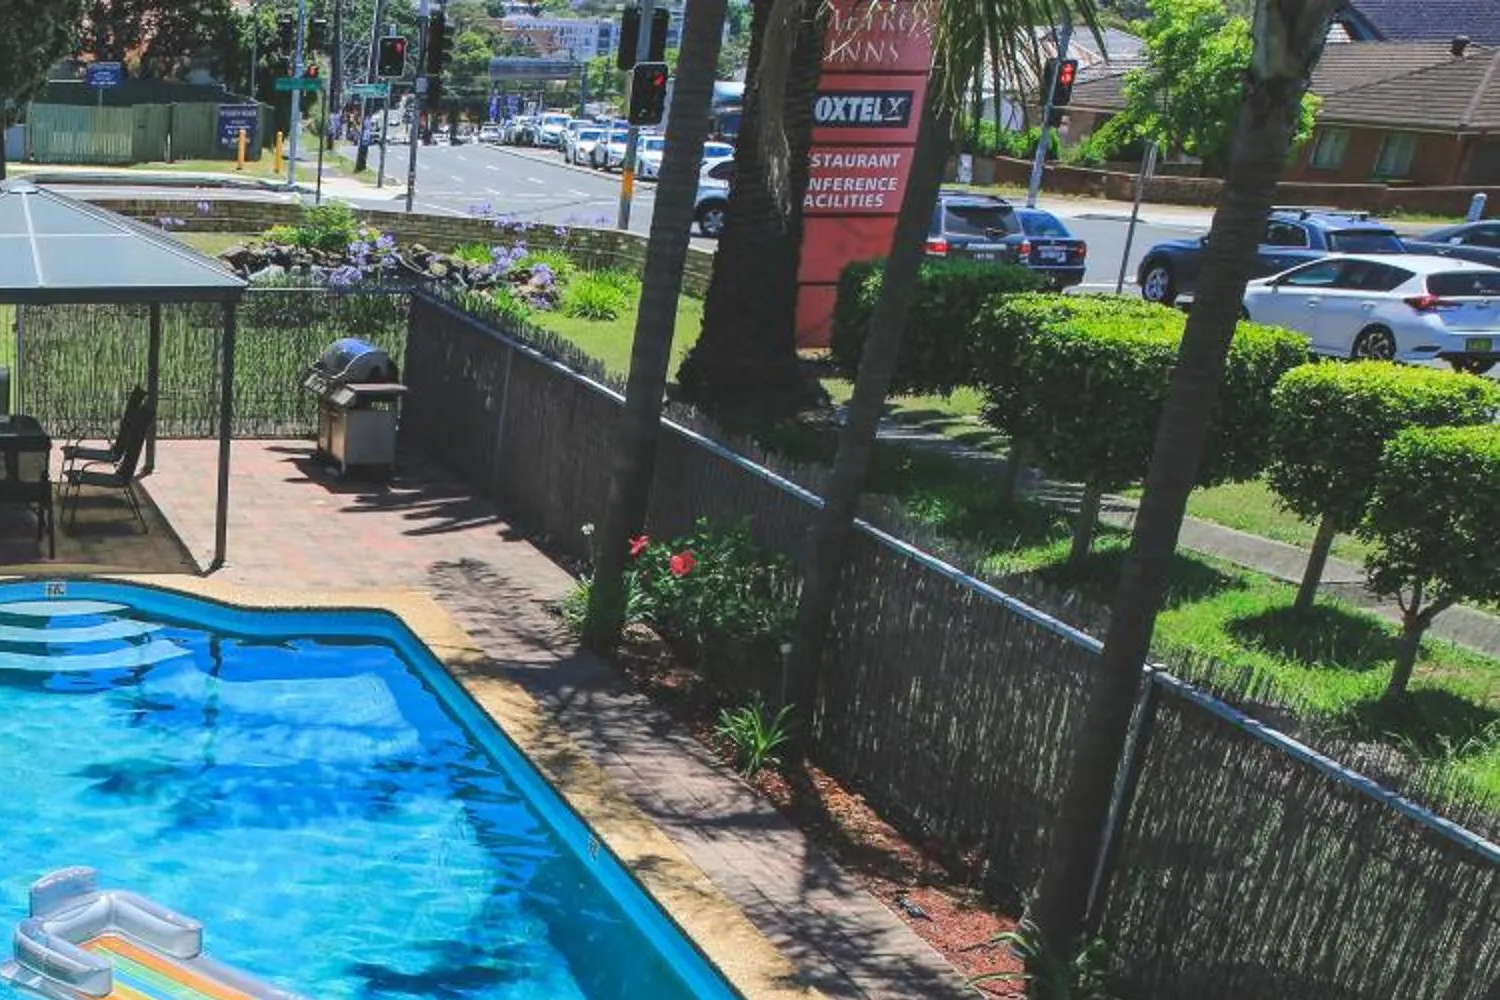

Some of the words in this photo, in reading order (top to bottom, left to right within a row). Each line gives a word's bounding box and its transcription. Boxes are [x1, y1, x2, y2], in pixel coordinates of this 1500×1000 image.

[814, 96, 885, 122] OXTEL
[809, 153, 901, 168] STAURANT
[808, 177, 899, 191] NFERENCE
[803, 193, 885, 208] ACILITIES
